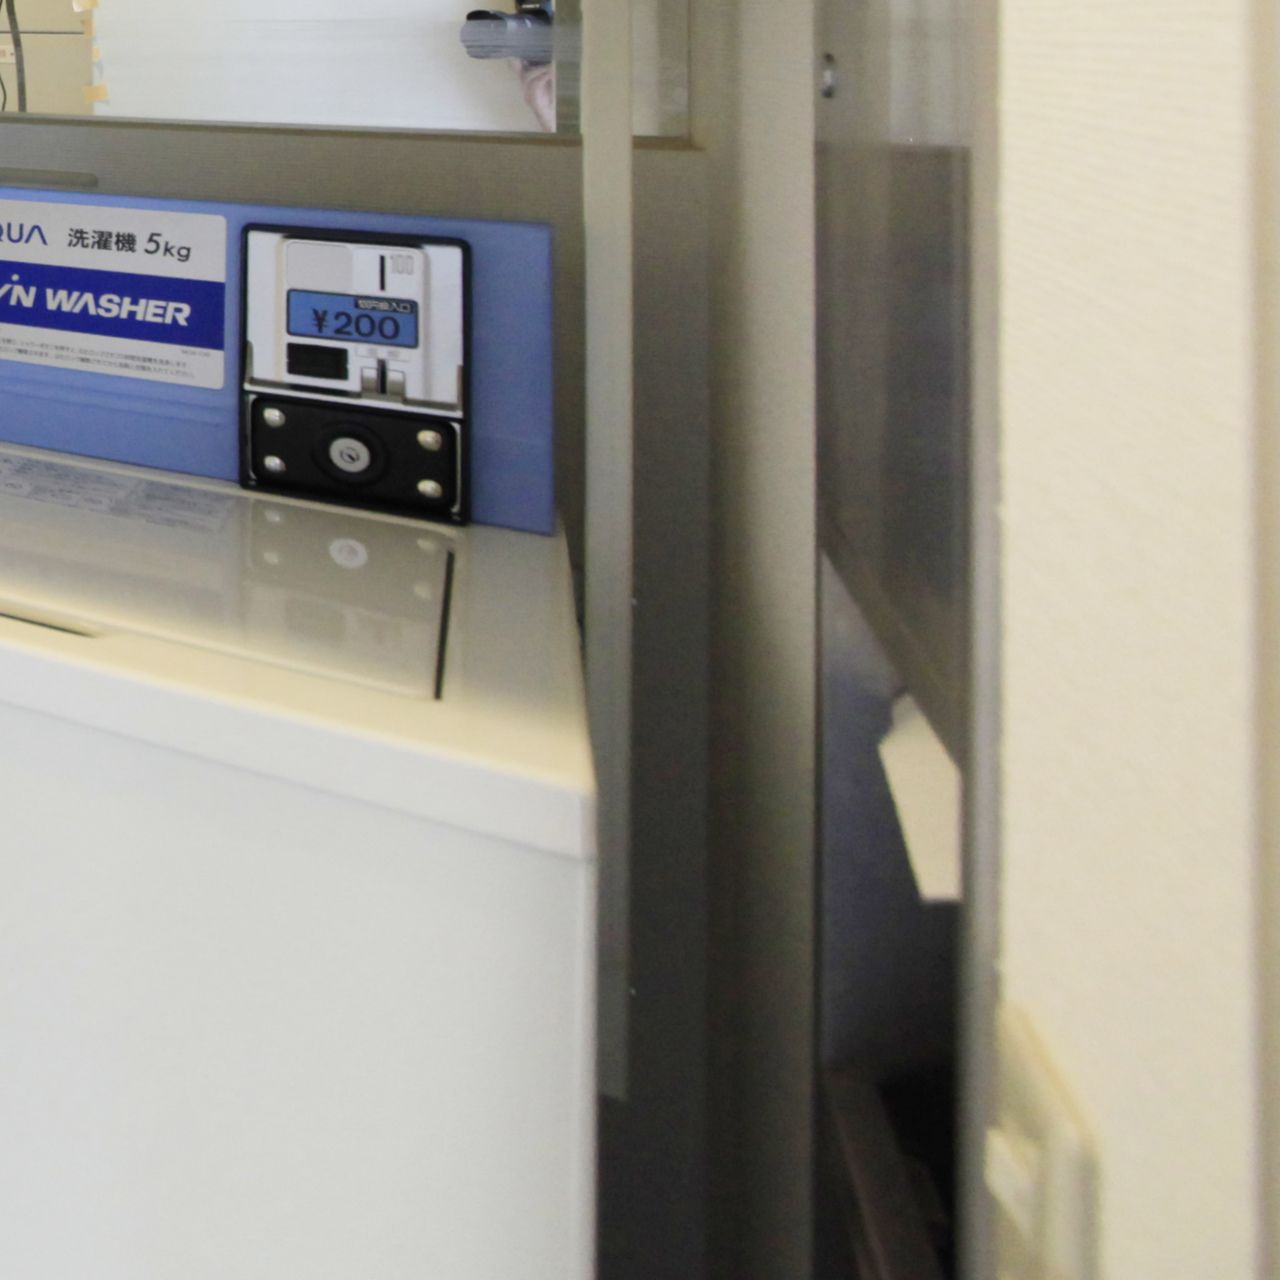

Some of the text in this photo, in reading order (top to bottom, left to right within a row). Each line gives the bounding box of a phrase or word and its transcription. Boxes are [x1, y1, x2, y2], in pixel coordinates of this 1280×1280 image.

[67, 227, 138, 256] 洗濯機
[143, 229, 193, 264] 5kg
[45, 286, 192, 327] WASHER
[312, 308, 401, 341] ¥200
